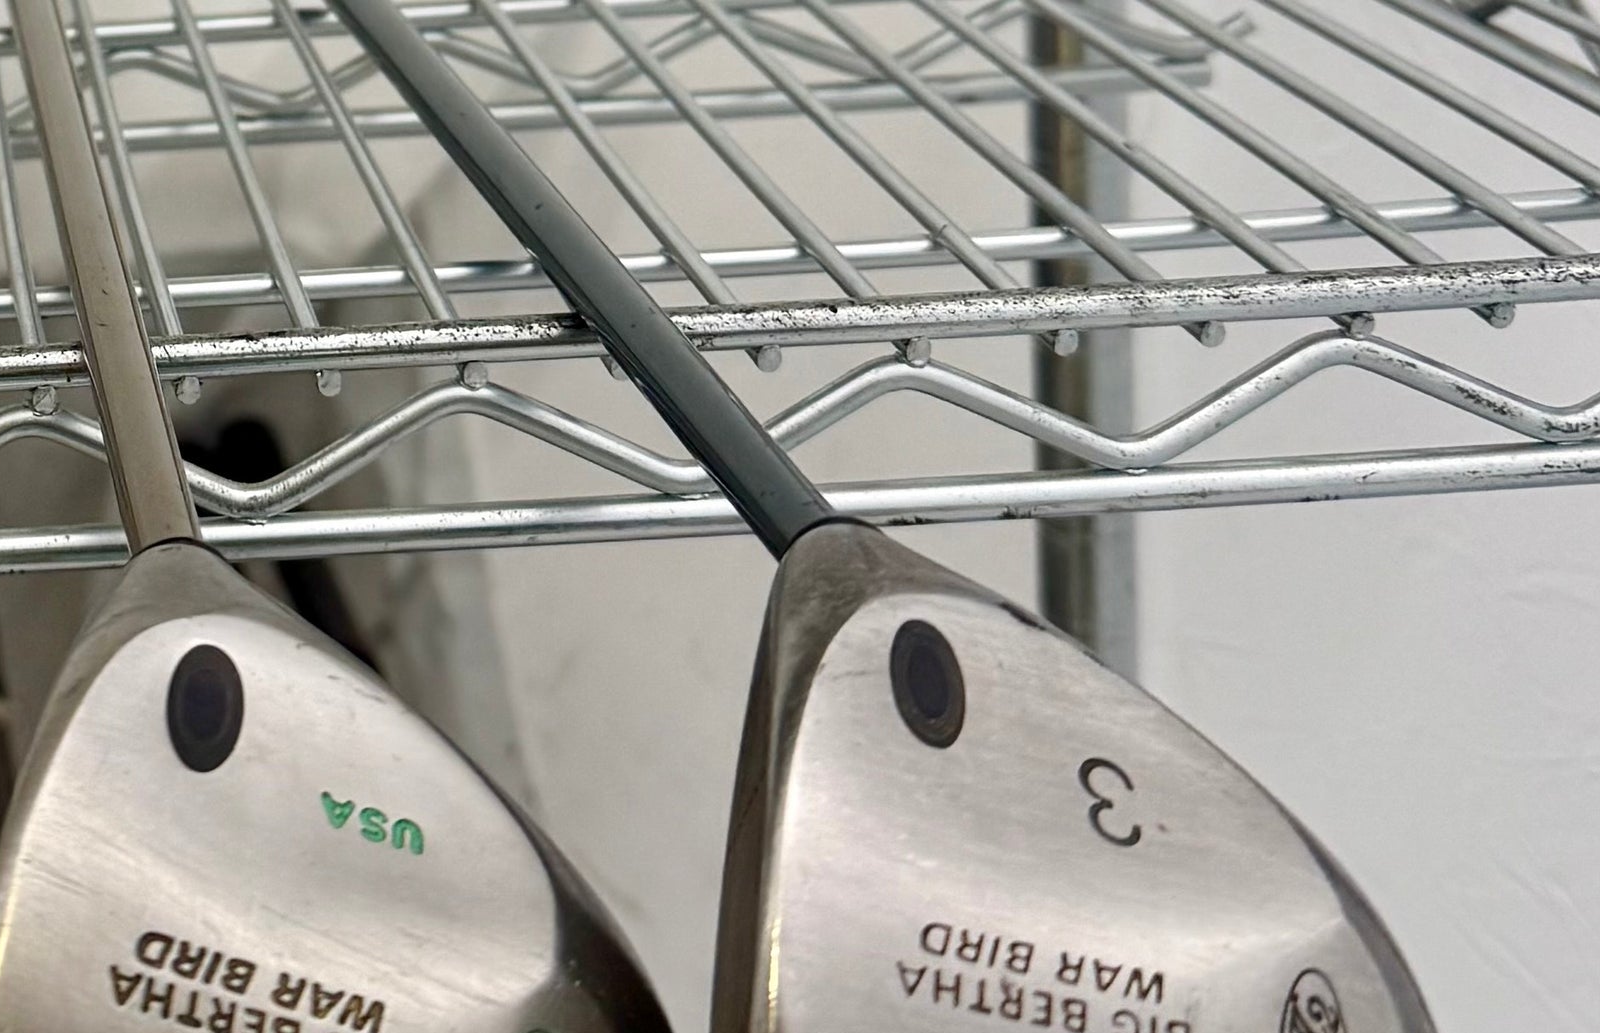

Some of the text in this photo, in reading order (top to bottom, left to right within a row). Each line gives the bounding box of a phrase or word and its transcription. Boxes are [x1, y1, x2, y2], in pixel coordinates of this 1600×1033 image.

[320, 790, 425, 856] USA
[1077, 757, 1142, 847] 3
[135, 930, 258, 995] BIRD
[919, 921, 1166, 1003] WAR BIRD
